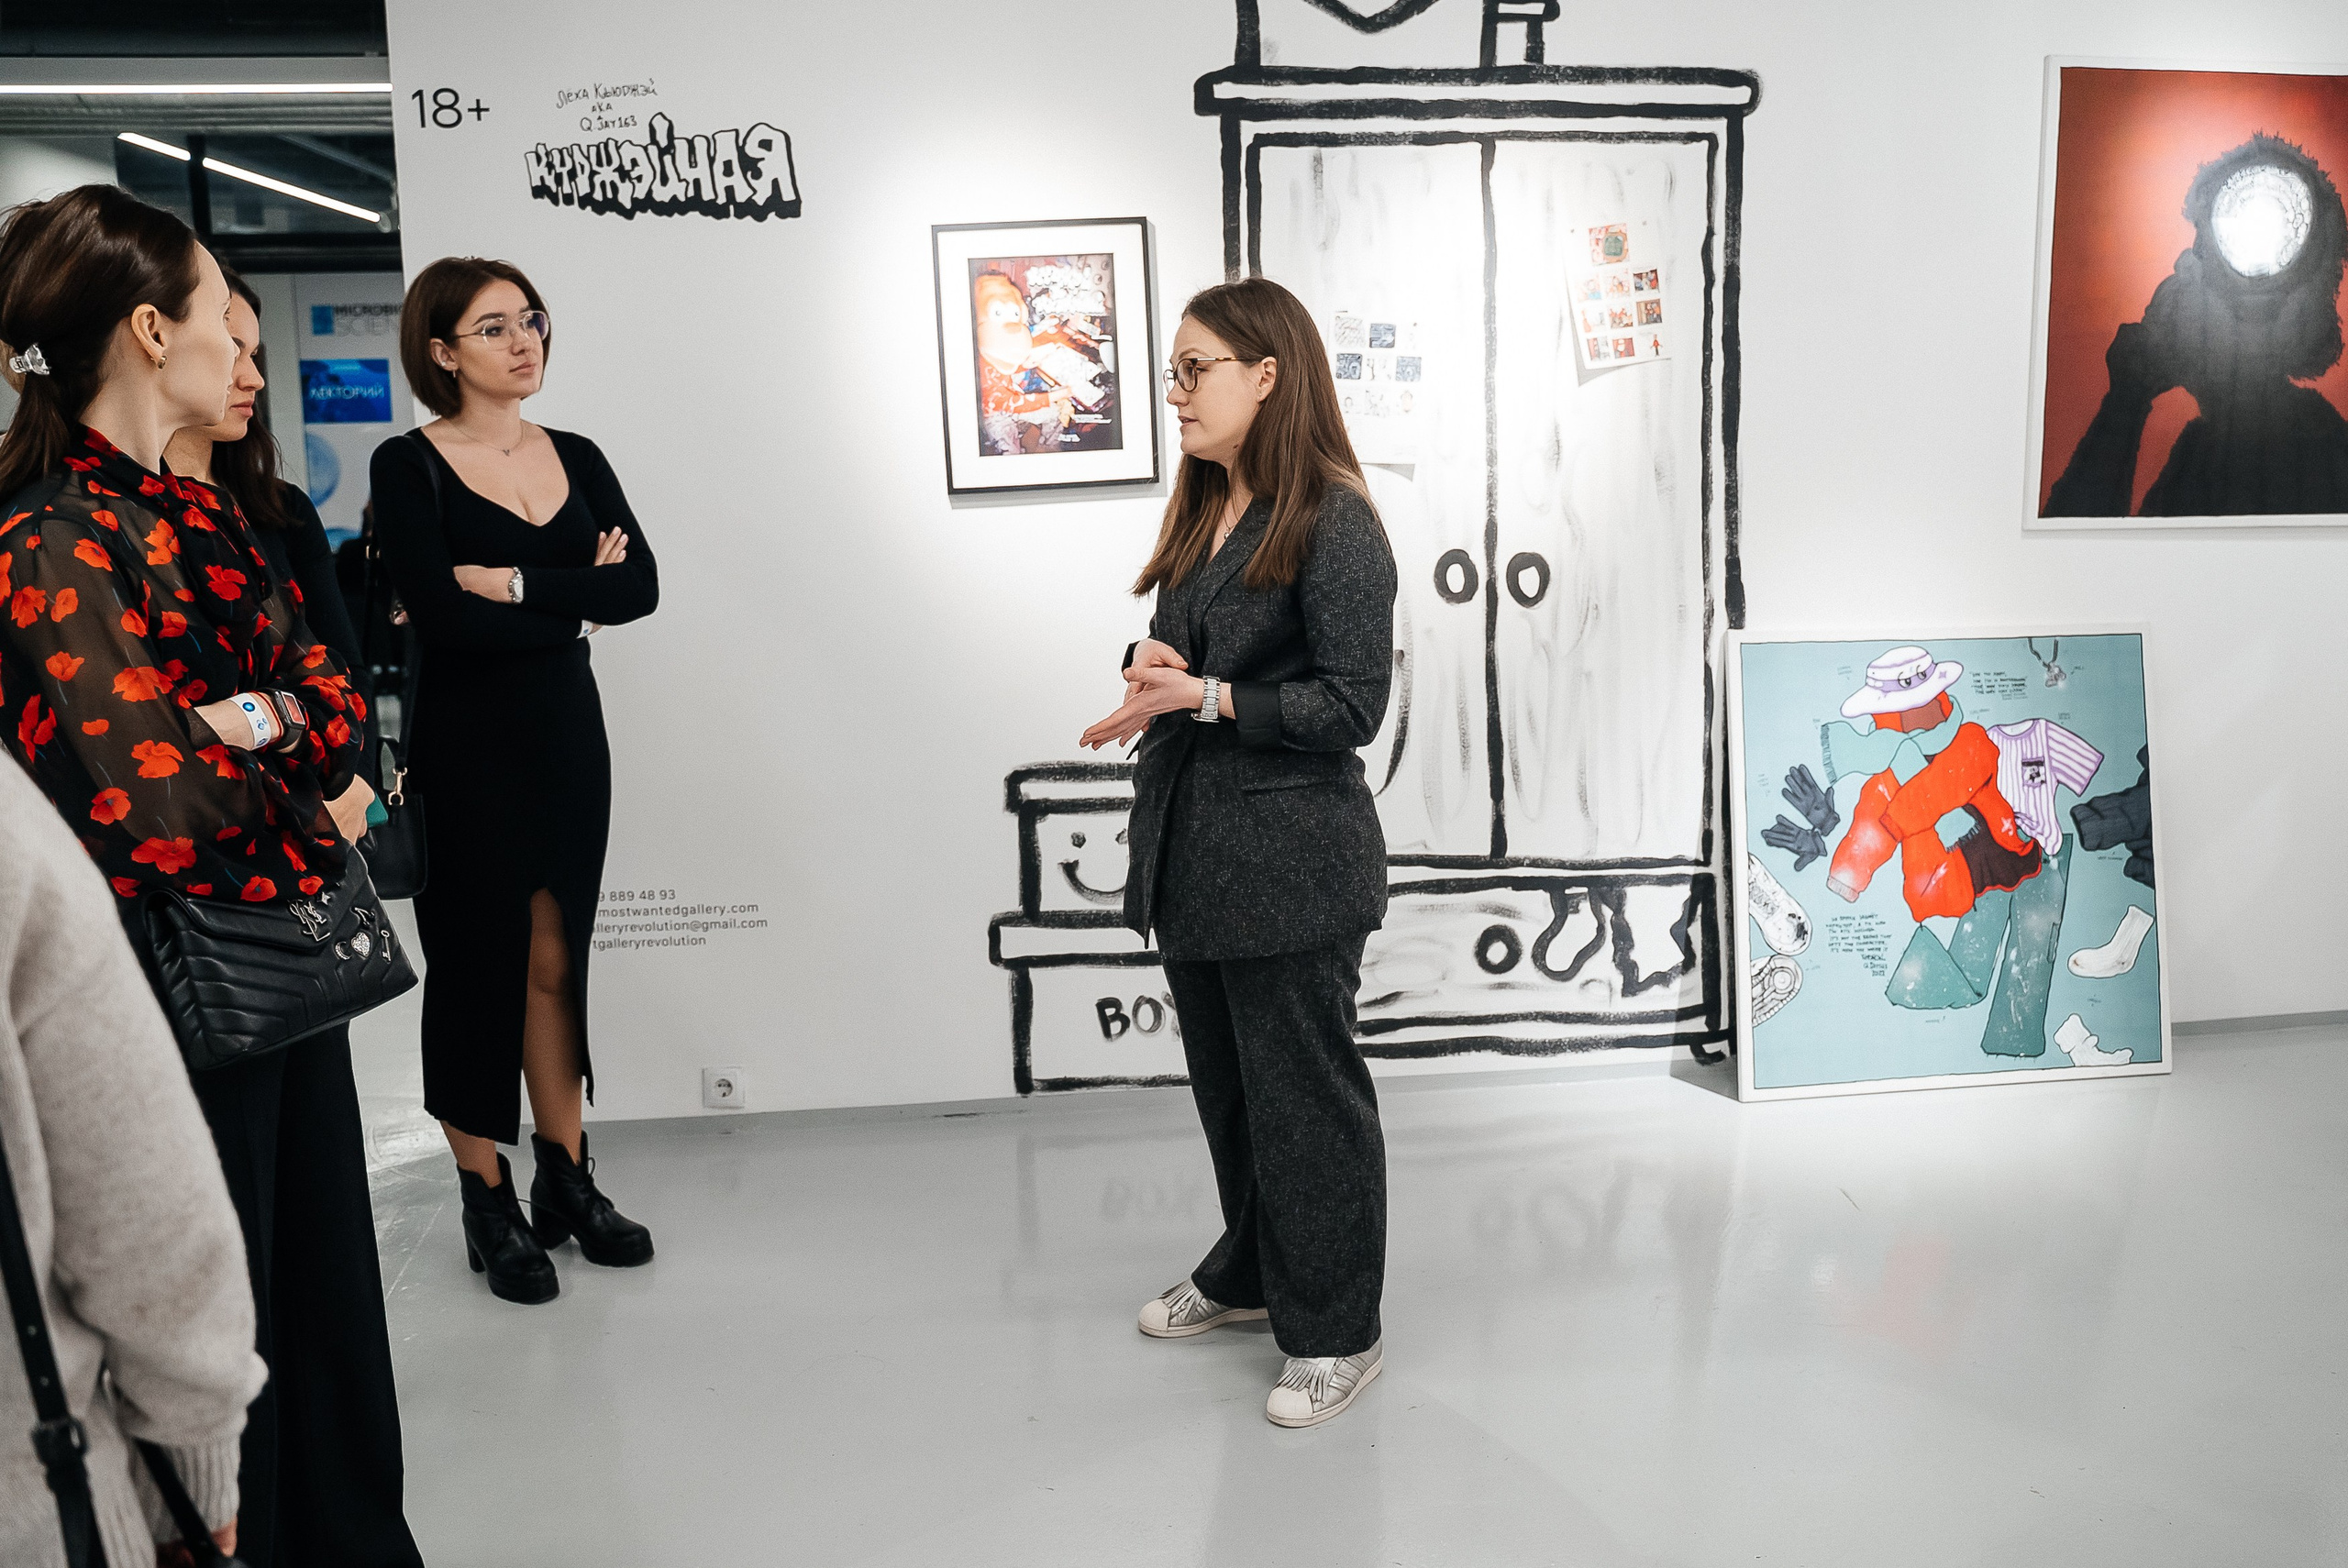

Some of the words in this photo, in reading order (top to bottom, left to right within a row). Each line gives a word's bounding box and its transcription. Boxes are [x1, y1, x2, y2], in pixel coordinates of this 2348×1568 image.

[412, 87, 491, 128] 18+
[609, 890, 635, 902] 889
[638, 889, 656, 901] 48
[659, 889, 676, 900] 93
